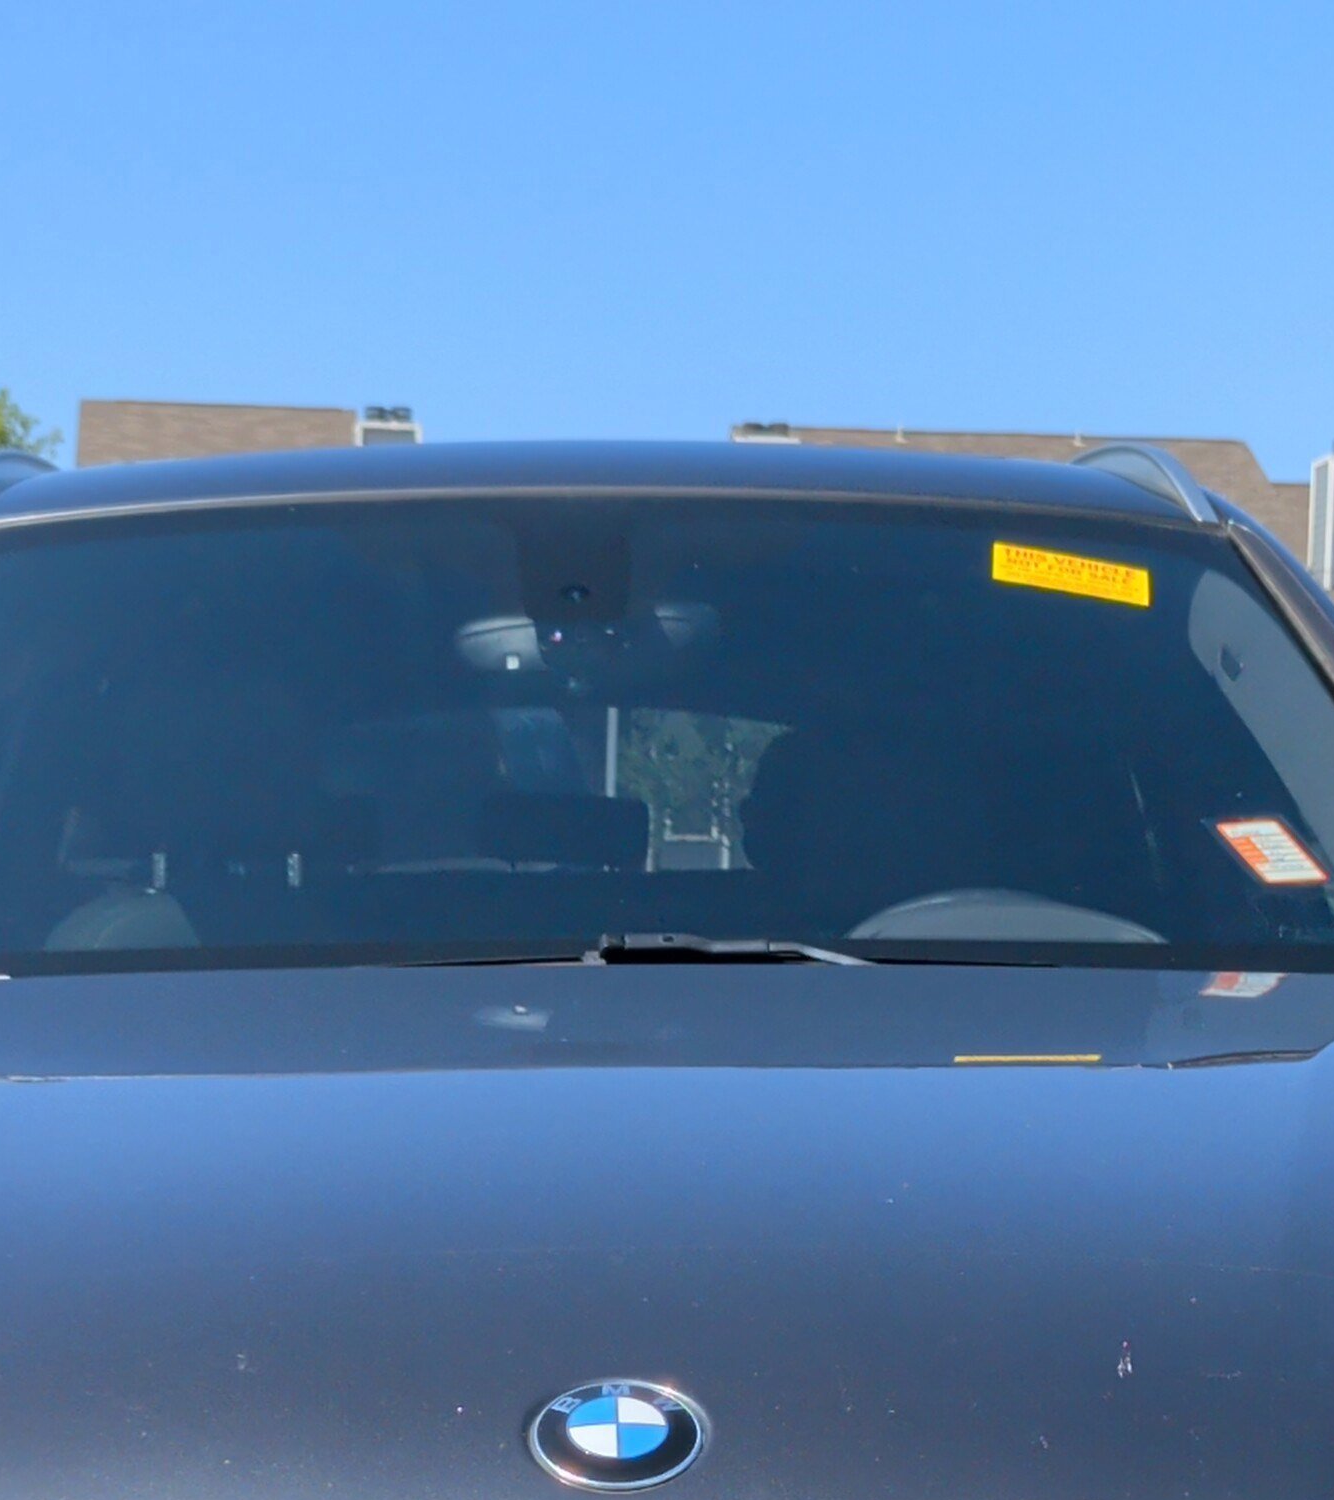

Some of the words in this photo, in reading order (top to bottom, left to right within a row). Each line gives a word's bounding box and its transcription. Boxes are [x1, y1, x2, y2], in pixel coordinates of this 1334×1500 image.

[1005, 548, 1047, 563] THIS
[1054, 556, 1134, 578] VEHICLE
[1007, 557, 1040, 569] NOT
[1047, 564, 1082, 576] FOR
[1089, 572, 1128, 585] SALE
[551, 1383, 684, 1414] BMW
